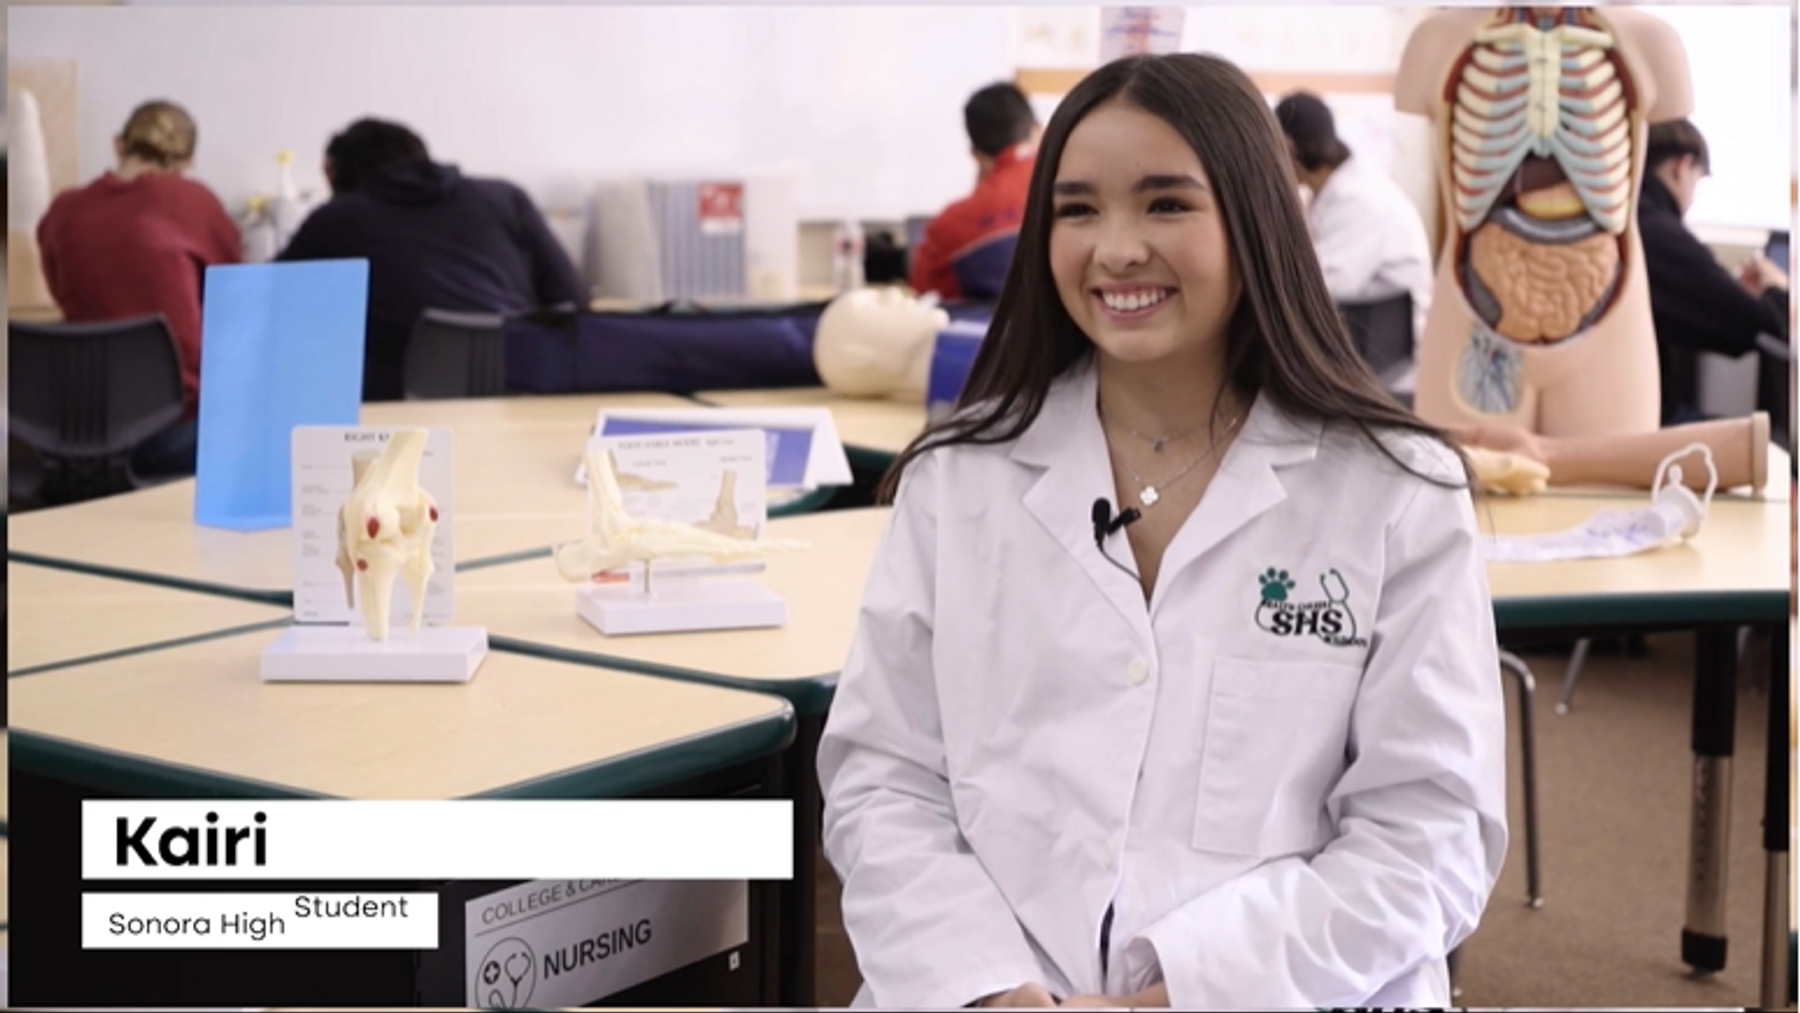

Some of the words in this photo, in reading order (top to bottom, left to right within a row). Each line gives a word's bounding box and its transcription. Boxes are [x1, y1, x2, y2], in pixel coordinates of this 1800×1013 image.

[1271, 608, 1342, 636] SHS
[481, 887, 562, 925] COLLEGE
[564, 880, 577, 897] &
[543, 918, 653, 980] NURSING
